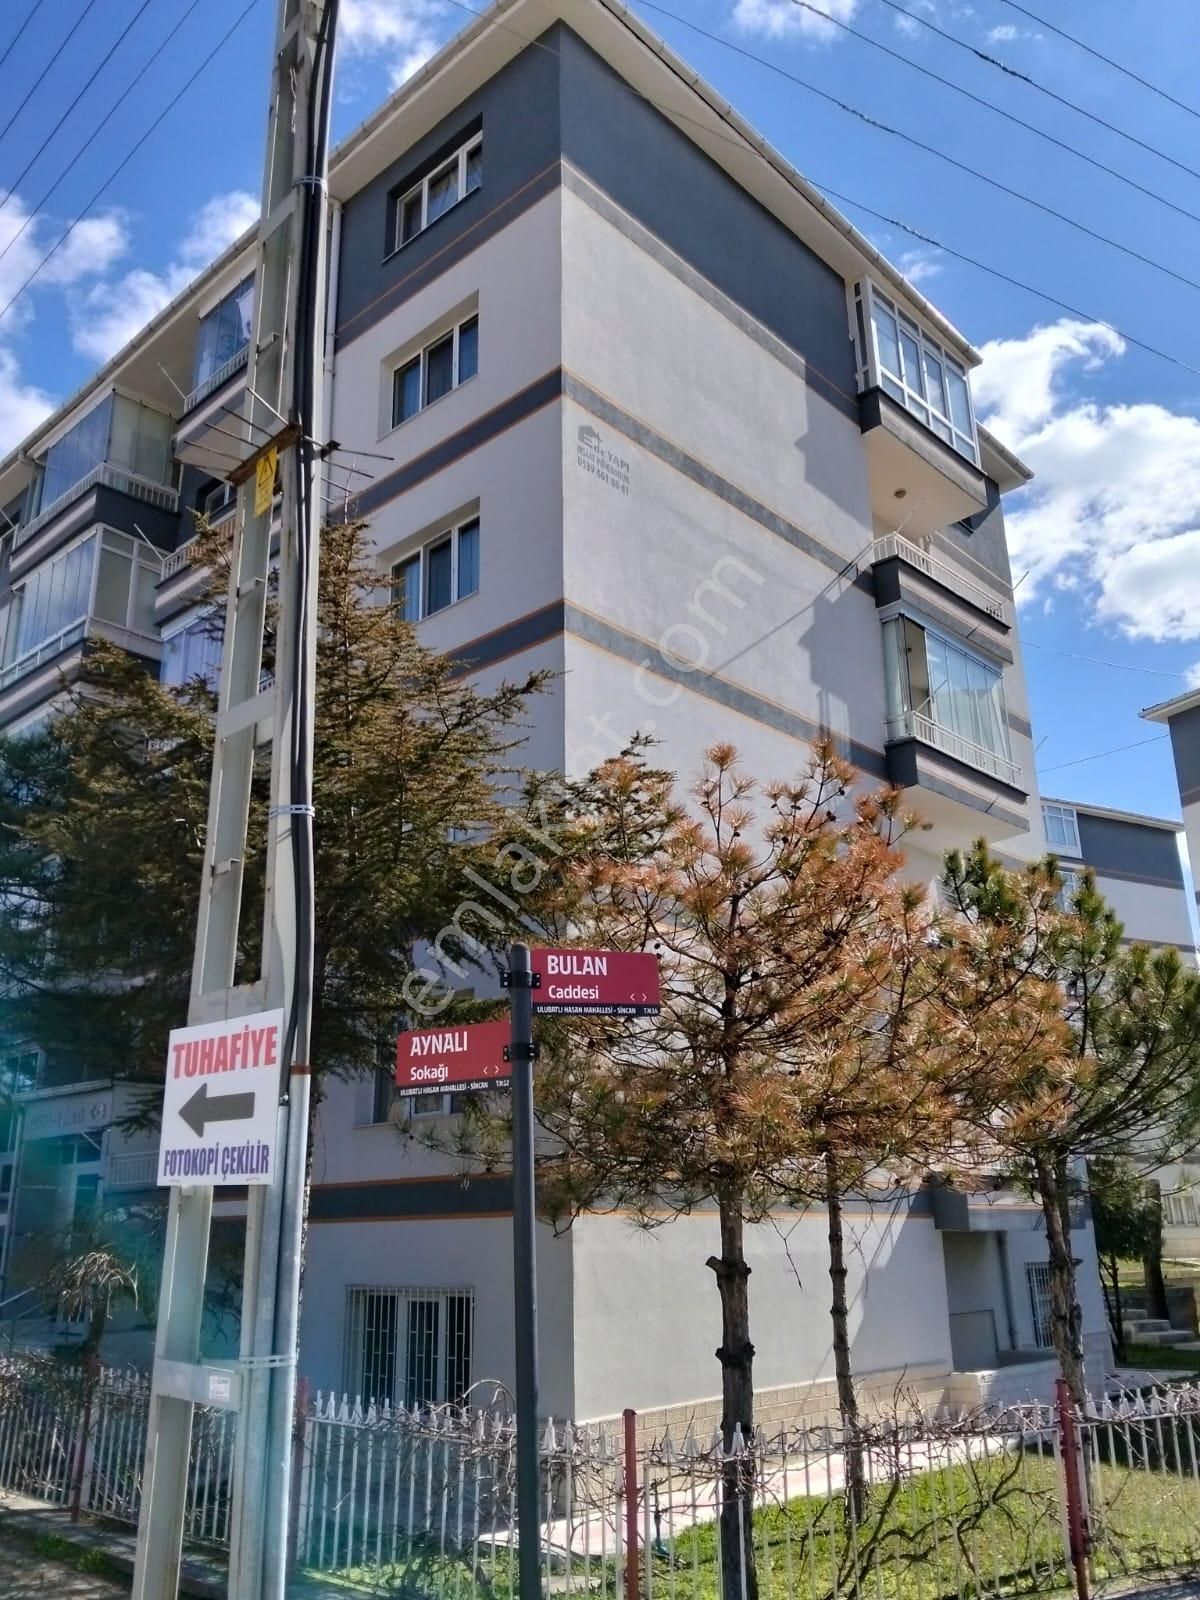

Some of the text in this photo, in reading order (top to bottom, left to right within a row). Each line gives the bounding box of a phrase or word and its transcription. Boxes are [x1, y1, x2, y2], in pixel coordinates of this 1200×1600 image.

[546, 954, 608, 976] BULAN
[548, 985, 599, 999] Caddesi
[536, 1005, 563, 1014] ULUBATLI
[563, 1006, 583, 1014] HASAN
[583, 1005, 613, 1014] MAHALLESİ
[617, 1006, 636, 1014] SİNCAN
[173, 1025, 278, 1079] TUHAFİYE
[410, 1031, 468, 1057] AYNALI
[410, 1063, 448, 1082] Sokağı
[400, 1087, 423, 1096] ULUBATLI
[423, 1086, 440, 1094] HASAN
[440, 1083, 466, 1093] MAHALLESİ
[470, 1081, 489, 1090] SİNCAN
[163, 1140, 270, 1181] FOTOKOPİ ÇEKİLİR
